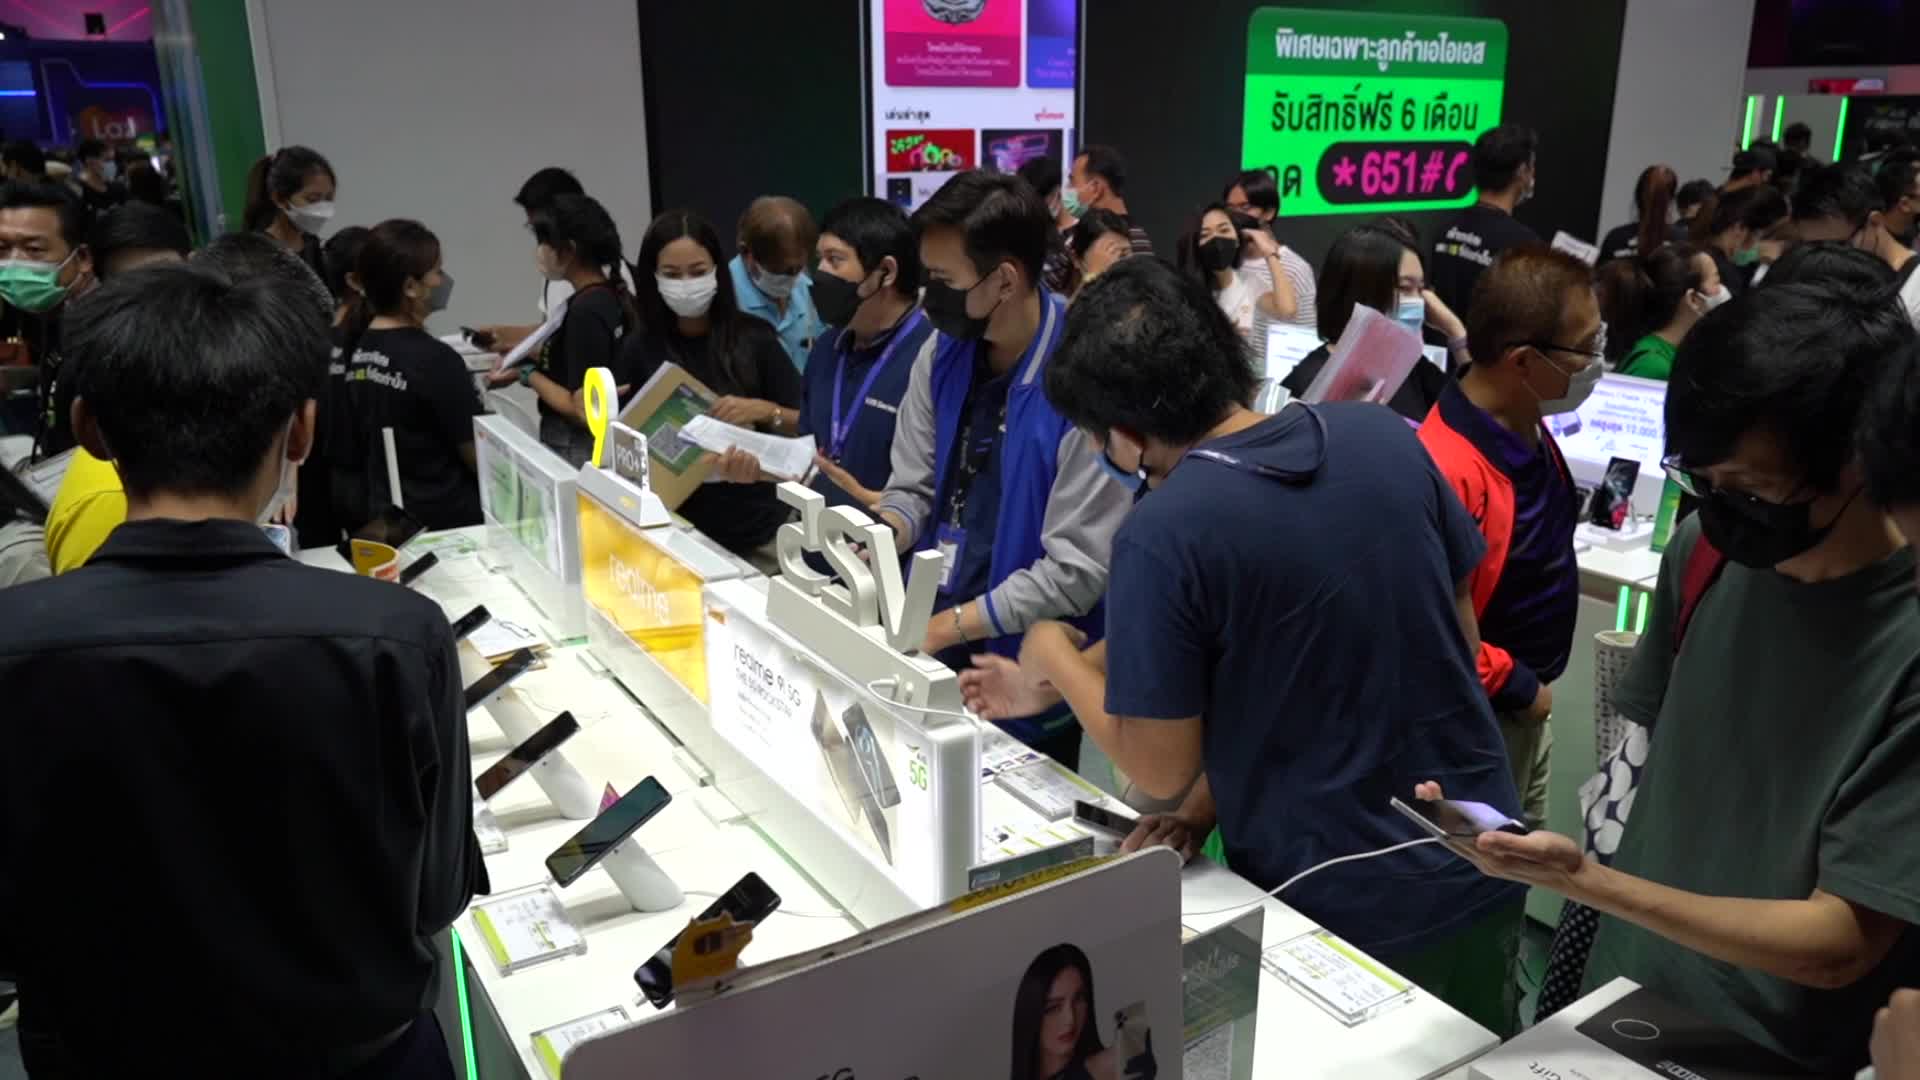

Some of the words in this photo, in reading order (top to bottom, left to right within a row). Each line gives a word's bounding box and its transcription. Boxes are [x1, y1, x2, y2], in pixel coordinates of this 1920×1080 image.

[1275, 28, 1486, 72] พิเศษเฉพาะลูกค้าเอไอเอส
[1271, 83, 1393, 132] รับสิทธิ์ฟรี
[1401, 98, 1416, 131] 6
[1424, 92, 1479, 132] เดือน
[608, 551, 671, 626] realme
[734, 643, 773, 686] realme
[910, 760, 928, 791] 5G
